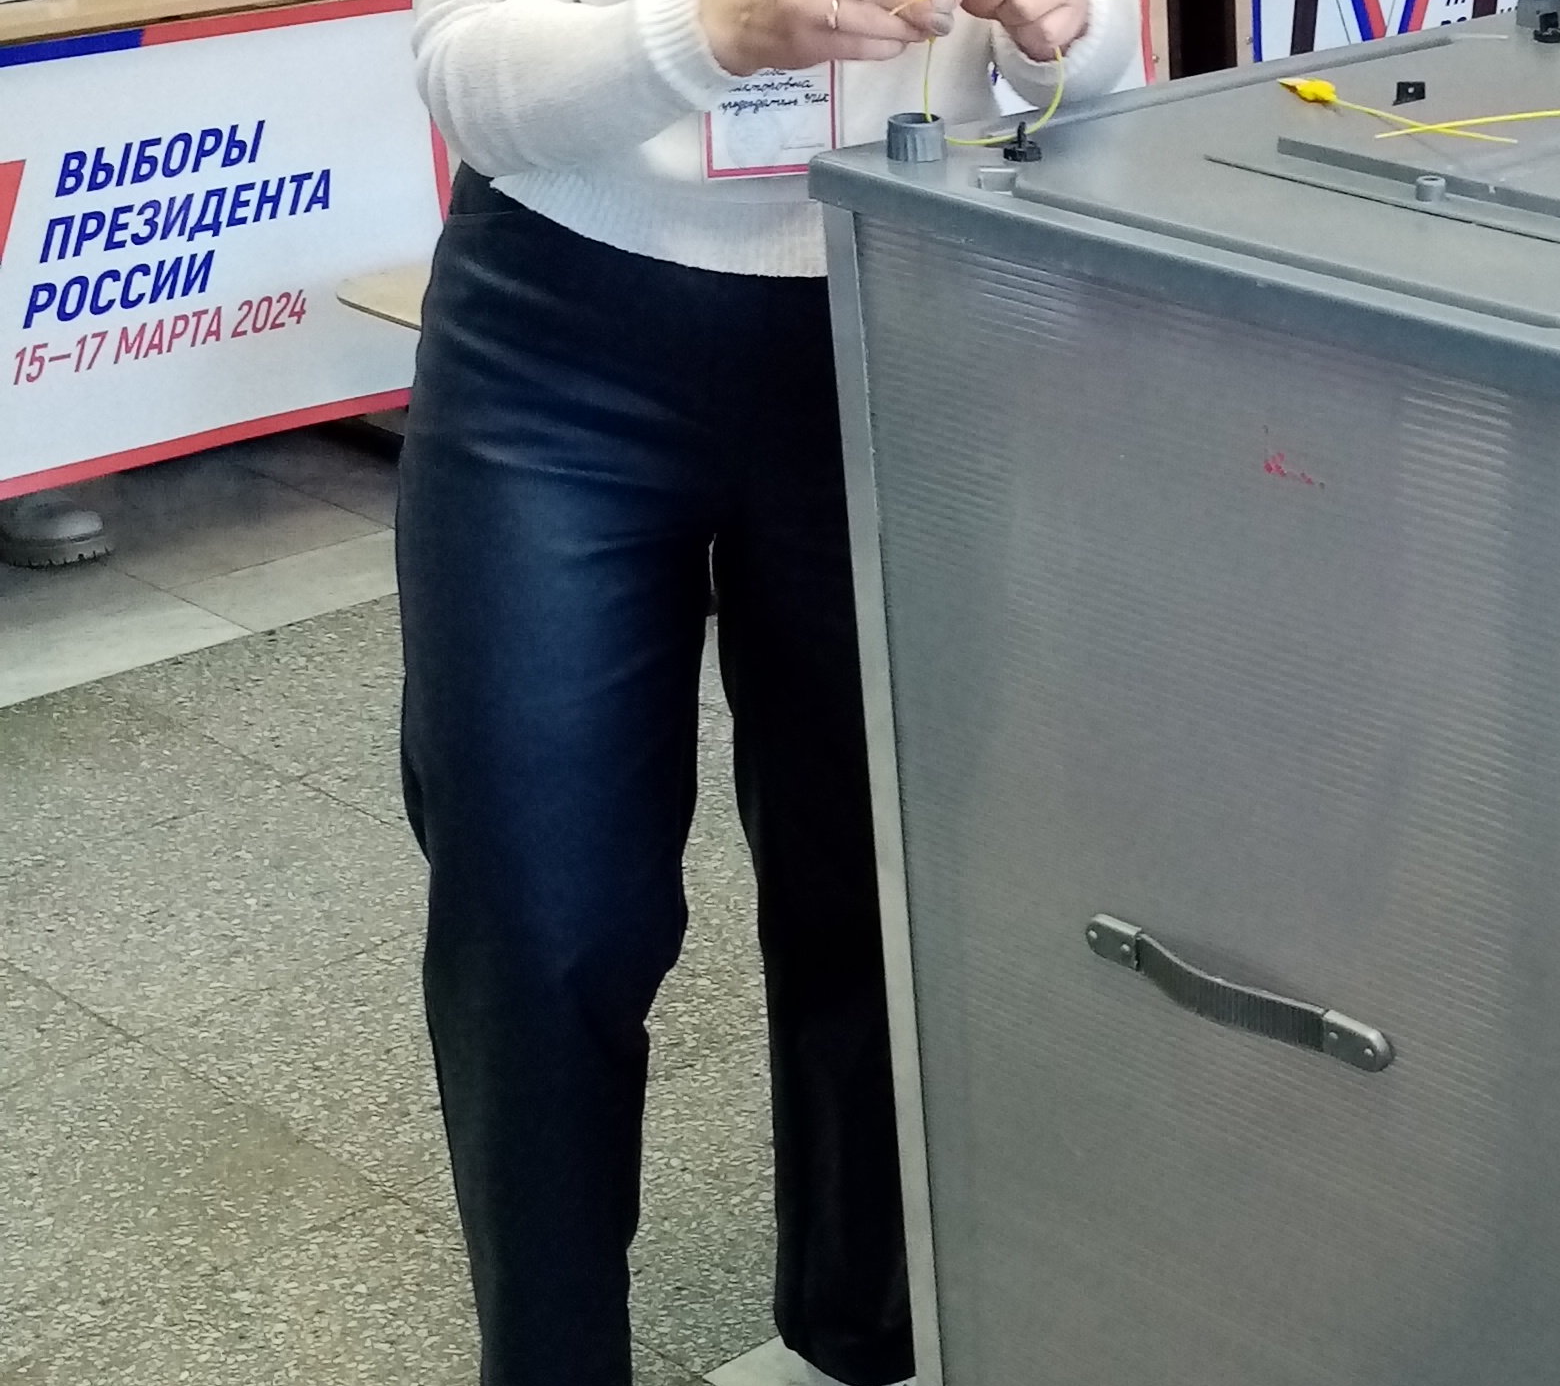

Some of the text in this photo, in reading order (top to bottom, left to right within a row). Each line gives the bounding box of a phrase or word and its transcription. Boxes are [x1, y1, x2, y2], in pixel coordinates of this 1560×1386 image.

[55, 120, 265, 197] ВЫБОРЫ
[39, 169, 331, 264] ПРЕЗИДЕНТА
[22, 249, 215, 329] РОССИИ
[113, 306, 222, 365] МАРТА
[231, 289, 307, 338] 2024
